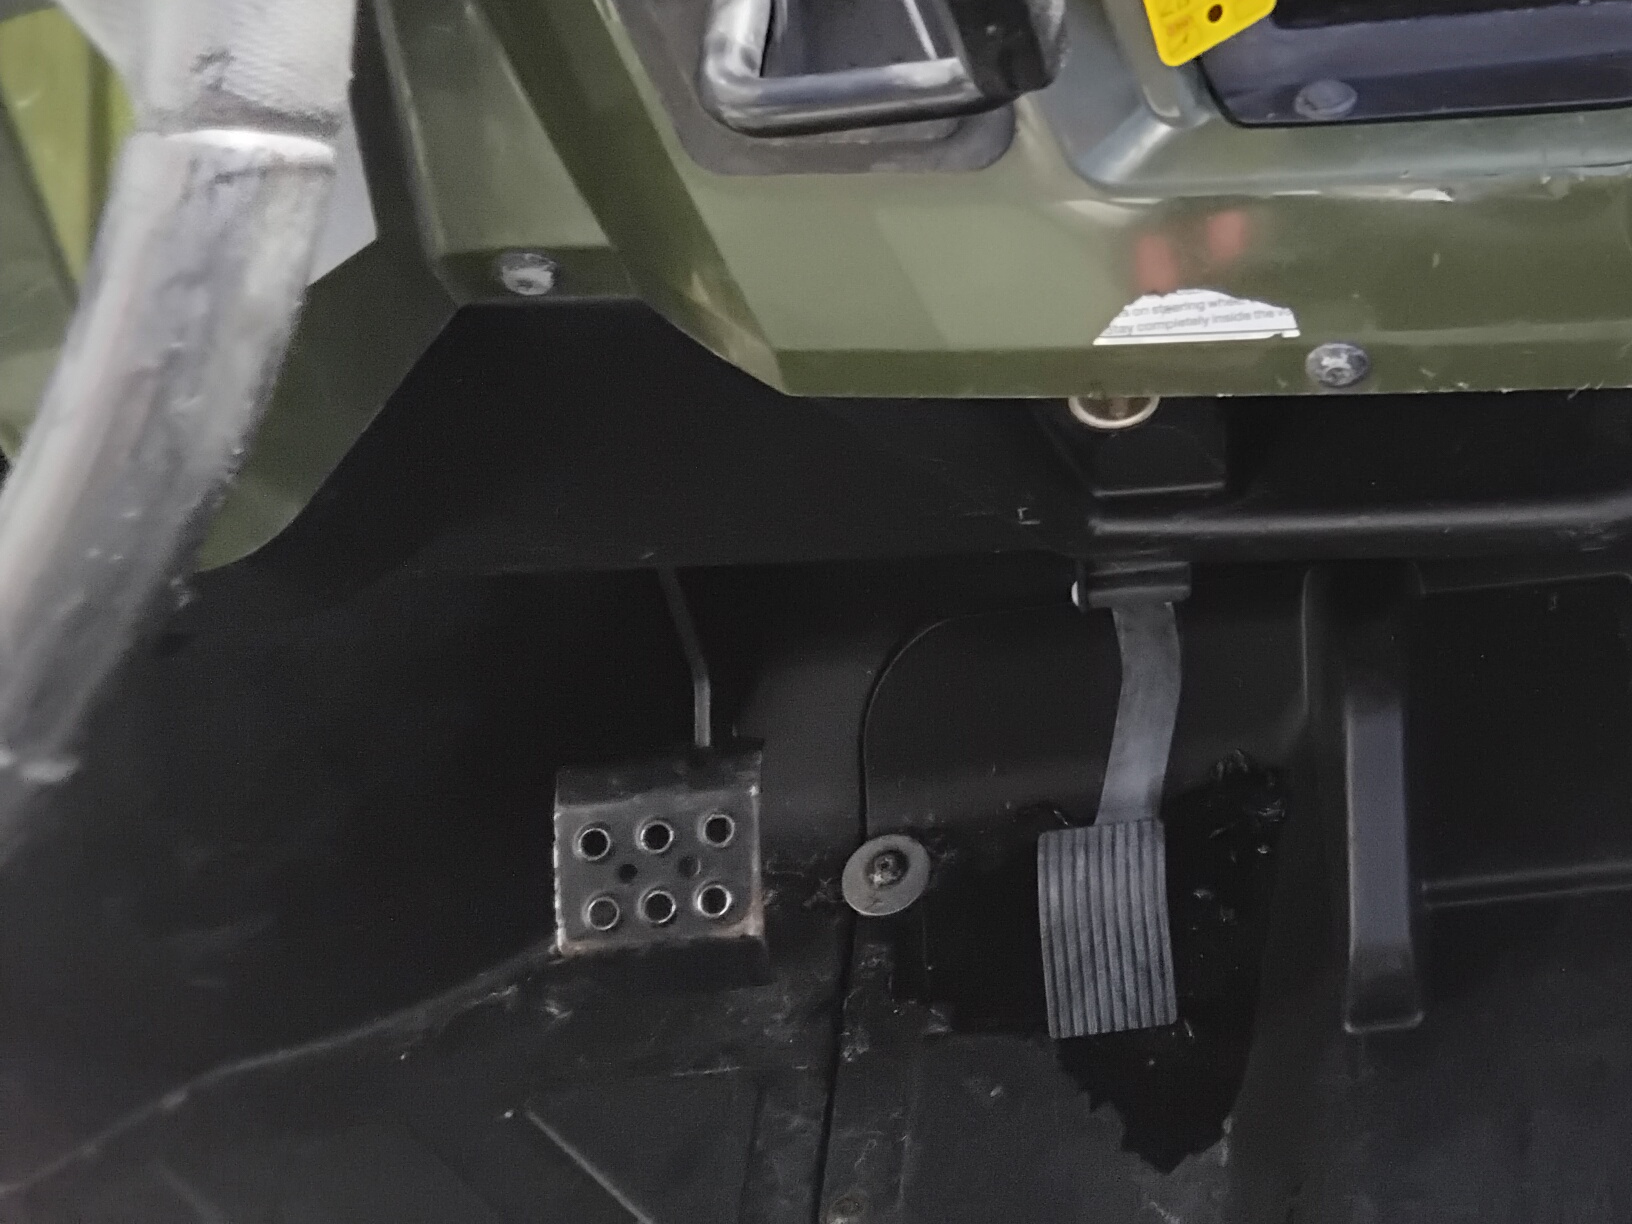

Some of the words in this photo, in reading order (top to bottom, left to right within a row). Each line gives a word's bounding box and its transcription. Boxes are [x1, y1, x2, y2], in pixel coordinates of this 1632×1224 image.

[1132, 307, 1150, 317] on
[1152, 301, 1206, 315] steering
[1137, 316, 1210, 332] completely
[1212, 312, 1252, 324] inside
[1253, 310, 1275, 319] the
